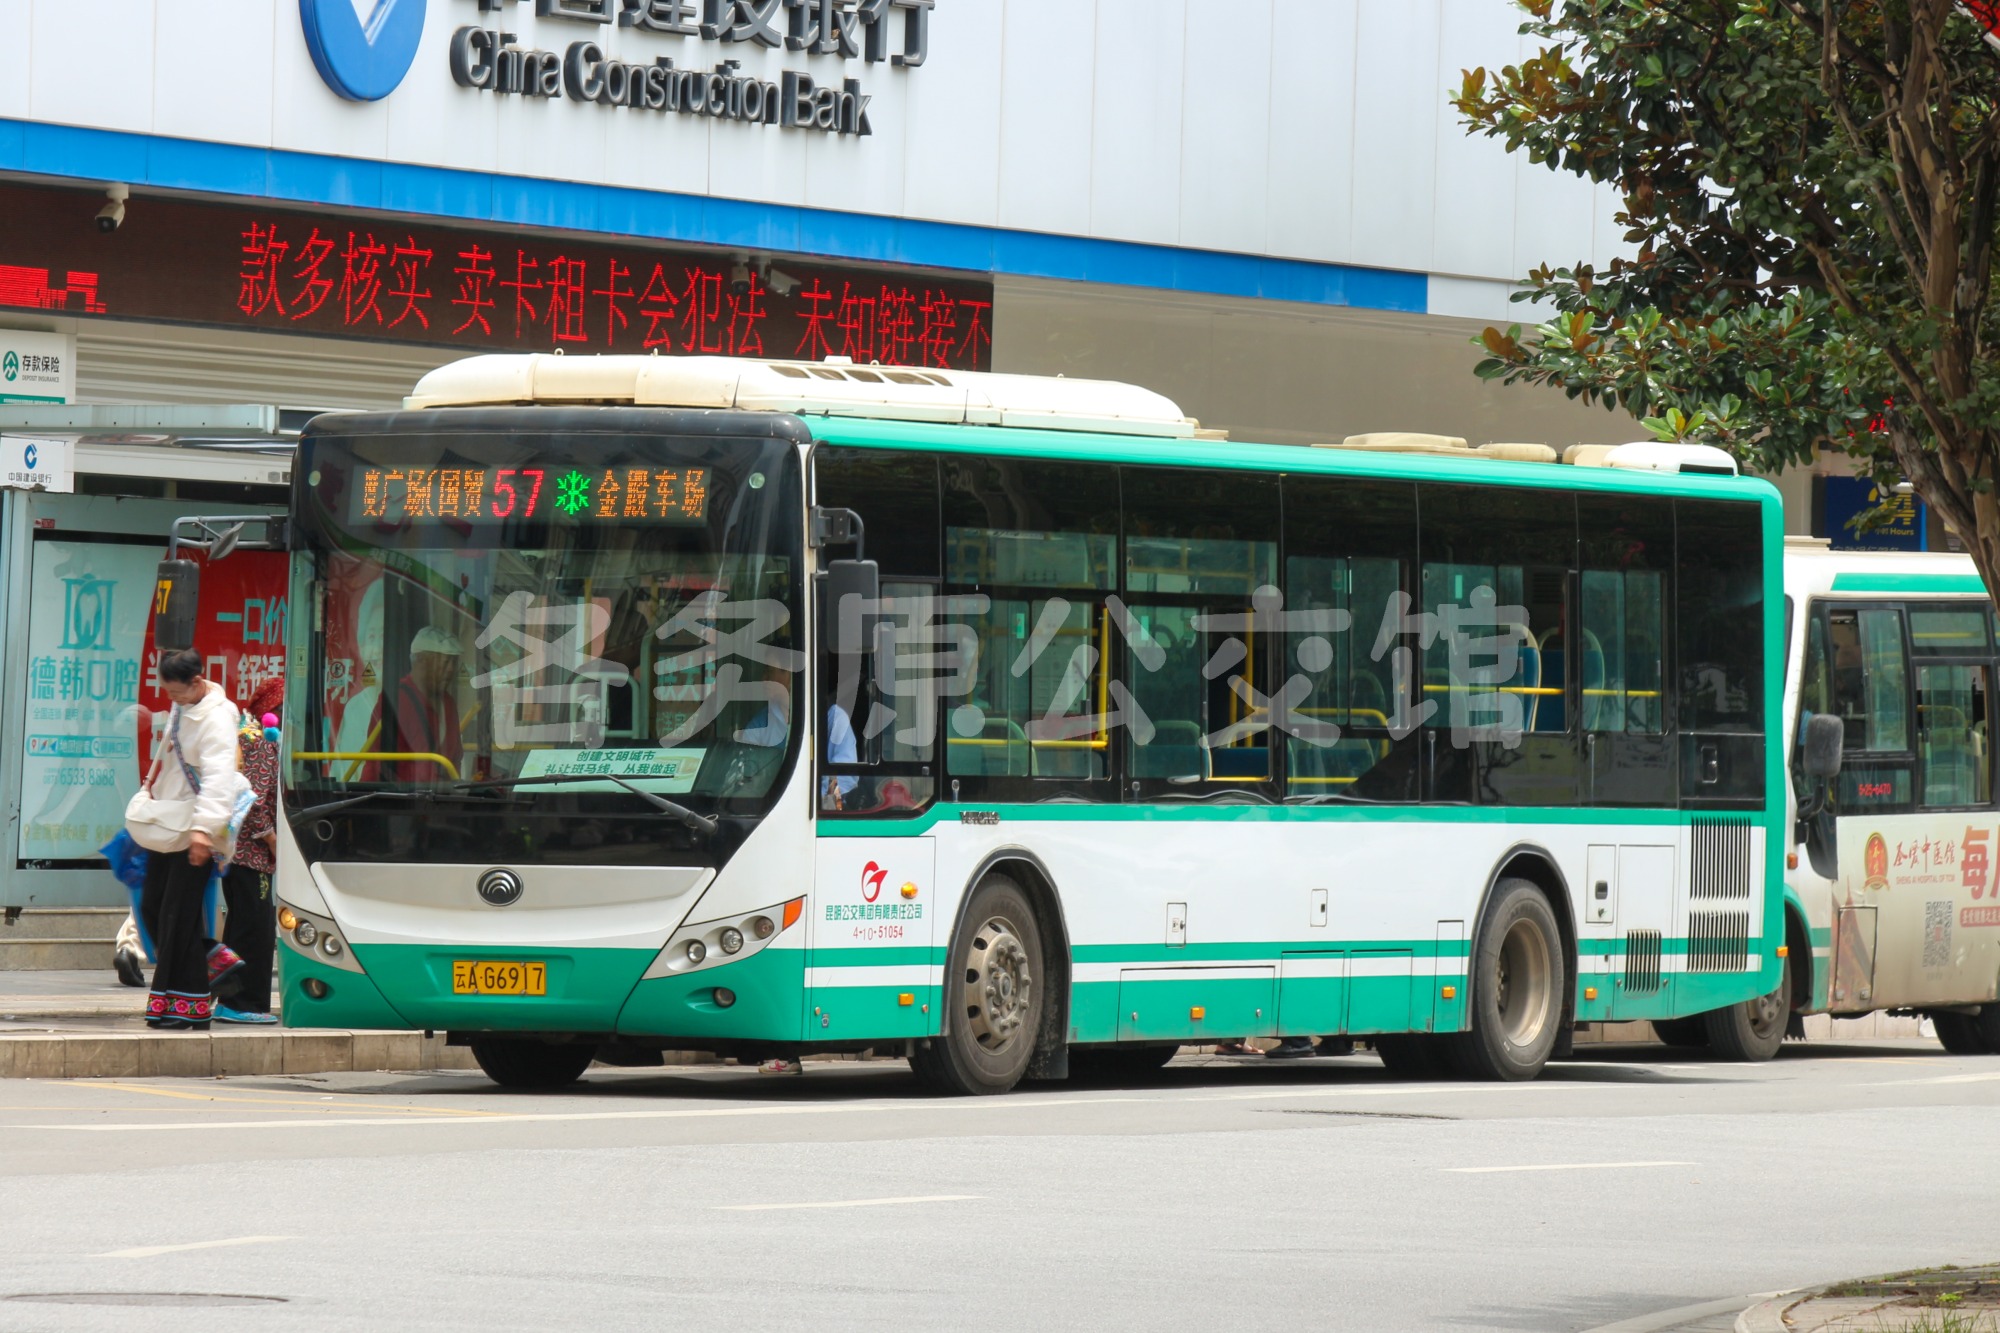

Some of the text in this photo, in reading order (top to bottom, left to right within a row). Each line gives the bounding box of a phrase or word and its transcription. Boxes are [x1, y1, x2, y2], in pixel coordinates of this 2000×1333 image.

[450, 25, 872, 135] China Construction Bank
[237, 221, 991, 371] 款多核实 卖卡租卡会犯法 未知链接不
[22, 355, 60, 373] 存款保险
[8, 472, 52, 483] 中国建设银行
[491, 469, 544, 517] 57
[31, 656, 138, 702] 德韩口腔
[576, 751, 656, 762] 创建文明城市
[826, 904, 922, 920] 昆明公交集团有限责任公司
